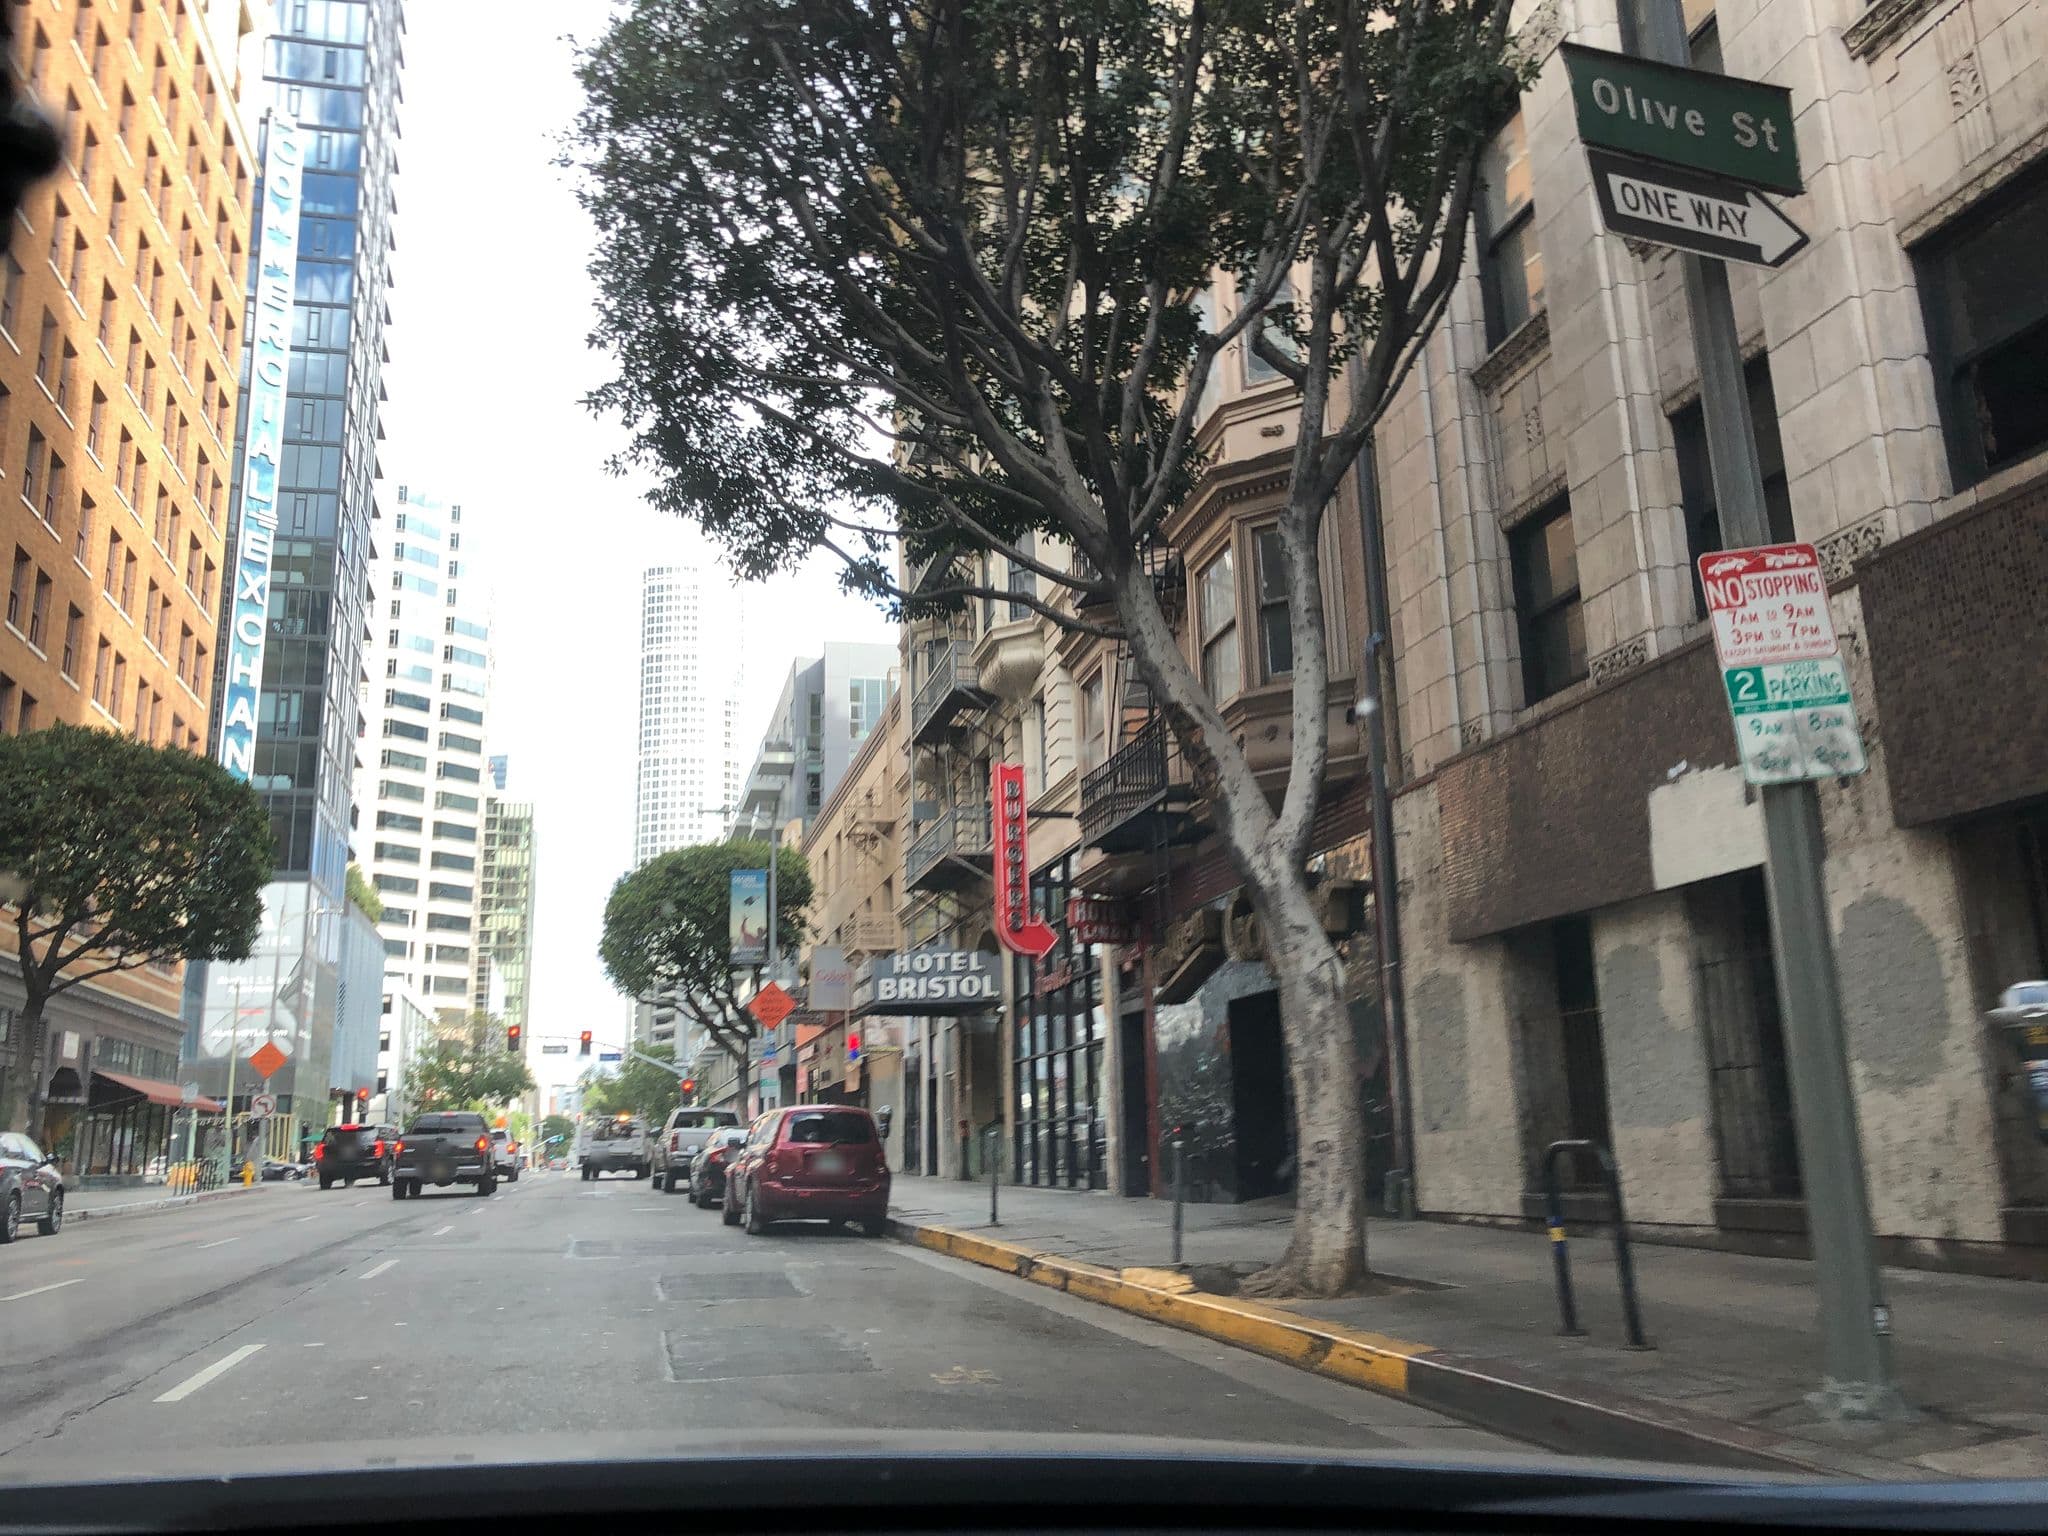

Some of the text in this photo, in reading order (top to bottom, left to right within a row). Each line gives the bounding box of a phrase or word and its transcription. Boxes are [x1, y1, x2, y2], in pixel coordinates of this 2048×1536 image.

[1592, 78, 1779, 152] Olive St
[1620, 181, 1747, 237] ONE WAY
[1706, 572, 1819, 609] NO STOPPING
[224, 534, 269, 773] EXCHAN
[1734, 670, 1759, 701] 2
[1769, 672, 1842, 700] PARKING
[892, 951, 987, 975] HOTEL
[878, 974, 1000, 1001] BRISTOL
